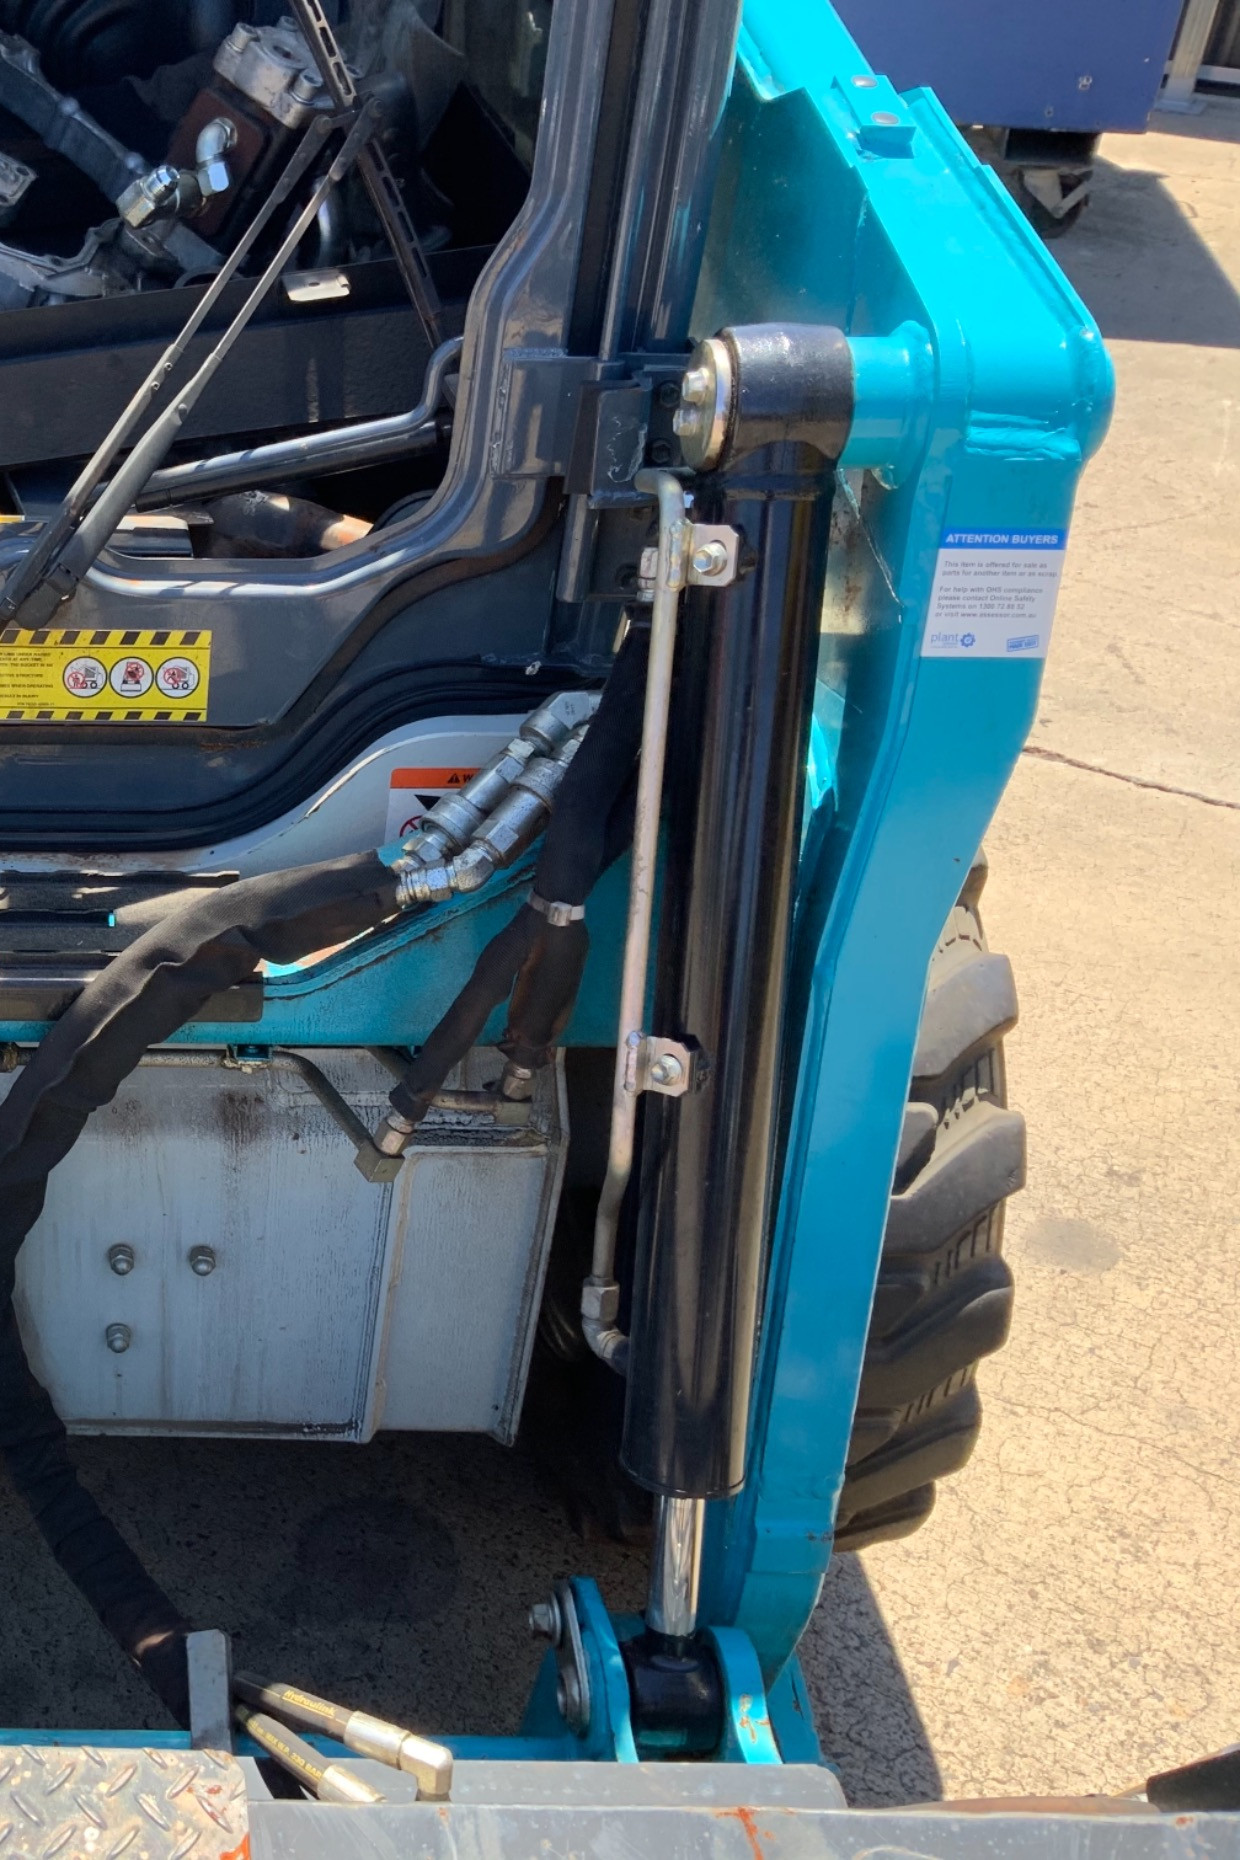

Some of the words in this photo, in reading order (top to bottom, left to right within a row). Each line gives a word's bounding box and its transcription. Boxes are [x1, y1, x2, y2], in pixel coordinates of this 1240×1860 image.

[945, 533, 1009, 544] ATTENTION
[1011, 534, 1059, 545] BUYERS
[930, 632, 959, 644] plant
